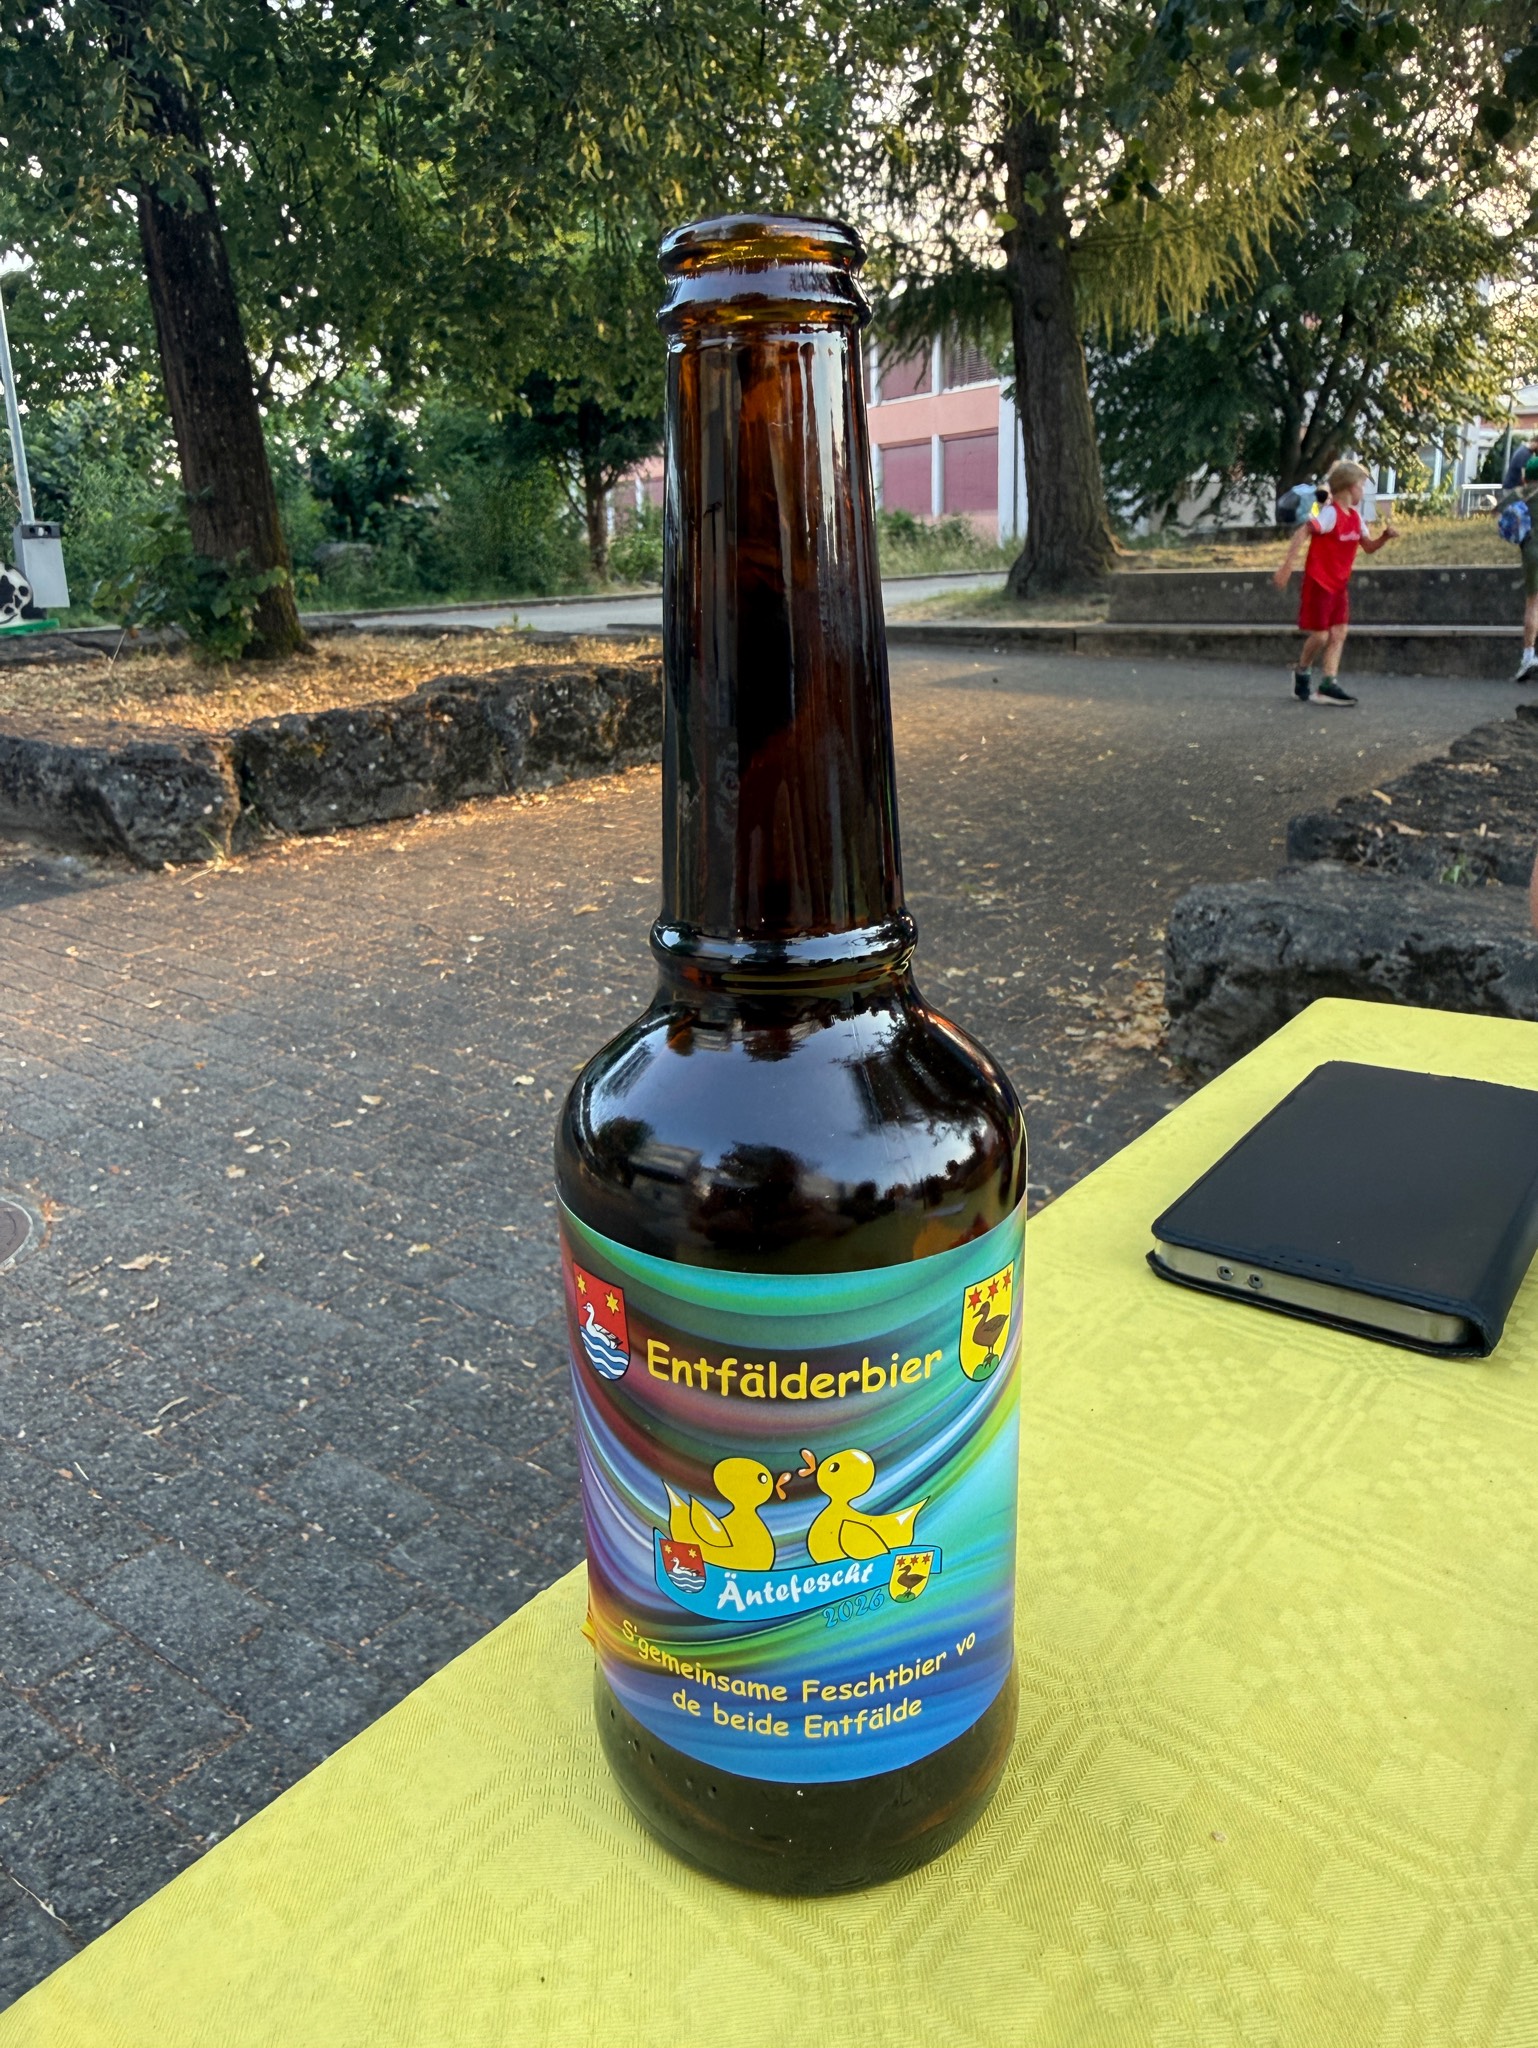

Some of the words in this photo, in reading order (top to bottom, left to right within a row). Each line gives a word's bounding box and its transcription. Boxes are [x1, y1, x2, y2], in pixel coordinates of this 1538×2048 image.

[647, 1338, 943, 1400] Entfälderbier
[716, 1562, 874, 1612] Äntefescht
[822, 1588, 885, 1629] 2026
[621, 1619, 788, 1702] S'gemeinsame
[801, 1652, 947, 1704] Feschtbier
[955, 1632, 977, 1657] vo
[672, 1688, 702, 1717] de
[713, 1702, 790, 1738] beide
[803, 1697, 923, 1739] Entfälde
